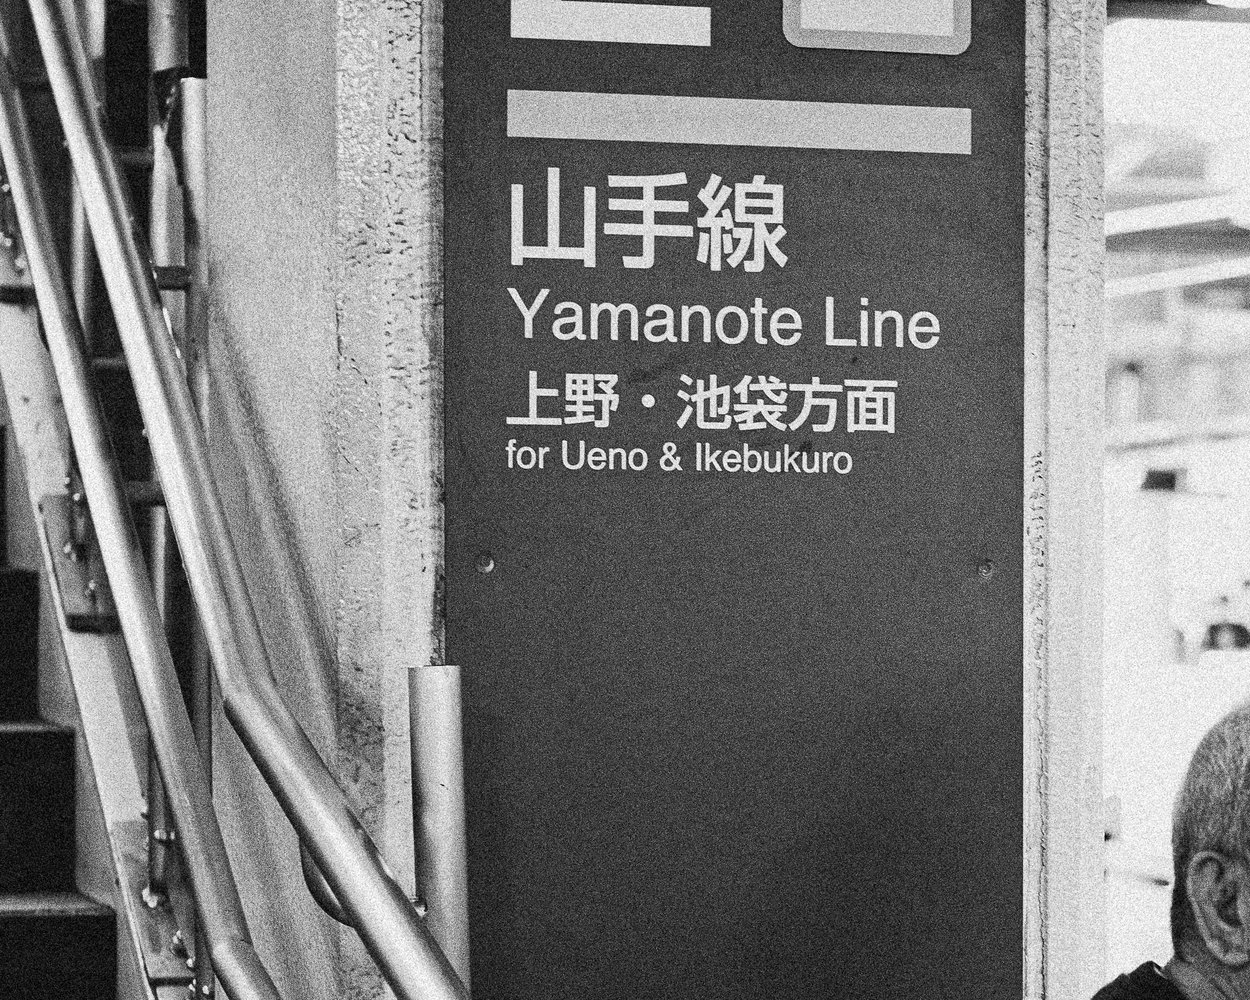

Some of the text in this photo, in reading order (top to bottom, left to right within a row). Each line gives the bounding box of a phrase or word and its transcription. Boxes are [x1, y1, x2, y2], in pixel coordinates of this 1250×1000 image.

[510, 166, 789, 273] 山手線
[506, 287, 941, 350] Yamanote Line
[505, 370, 899, 434] 上野・池袋方面
[505, 438, 853, 475] for Ueno & Ikebukuro
